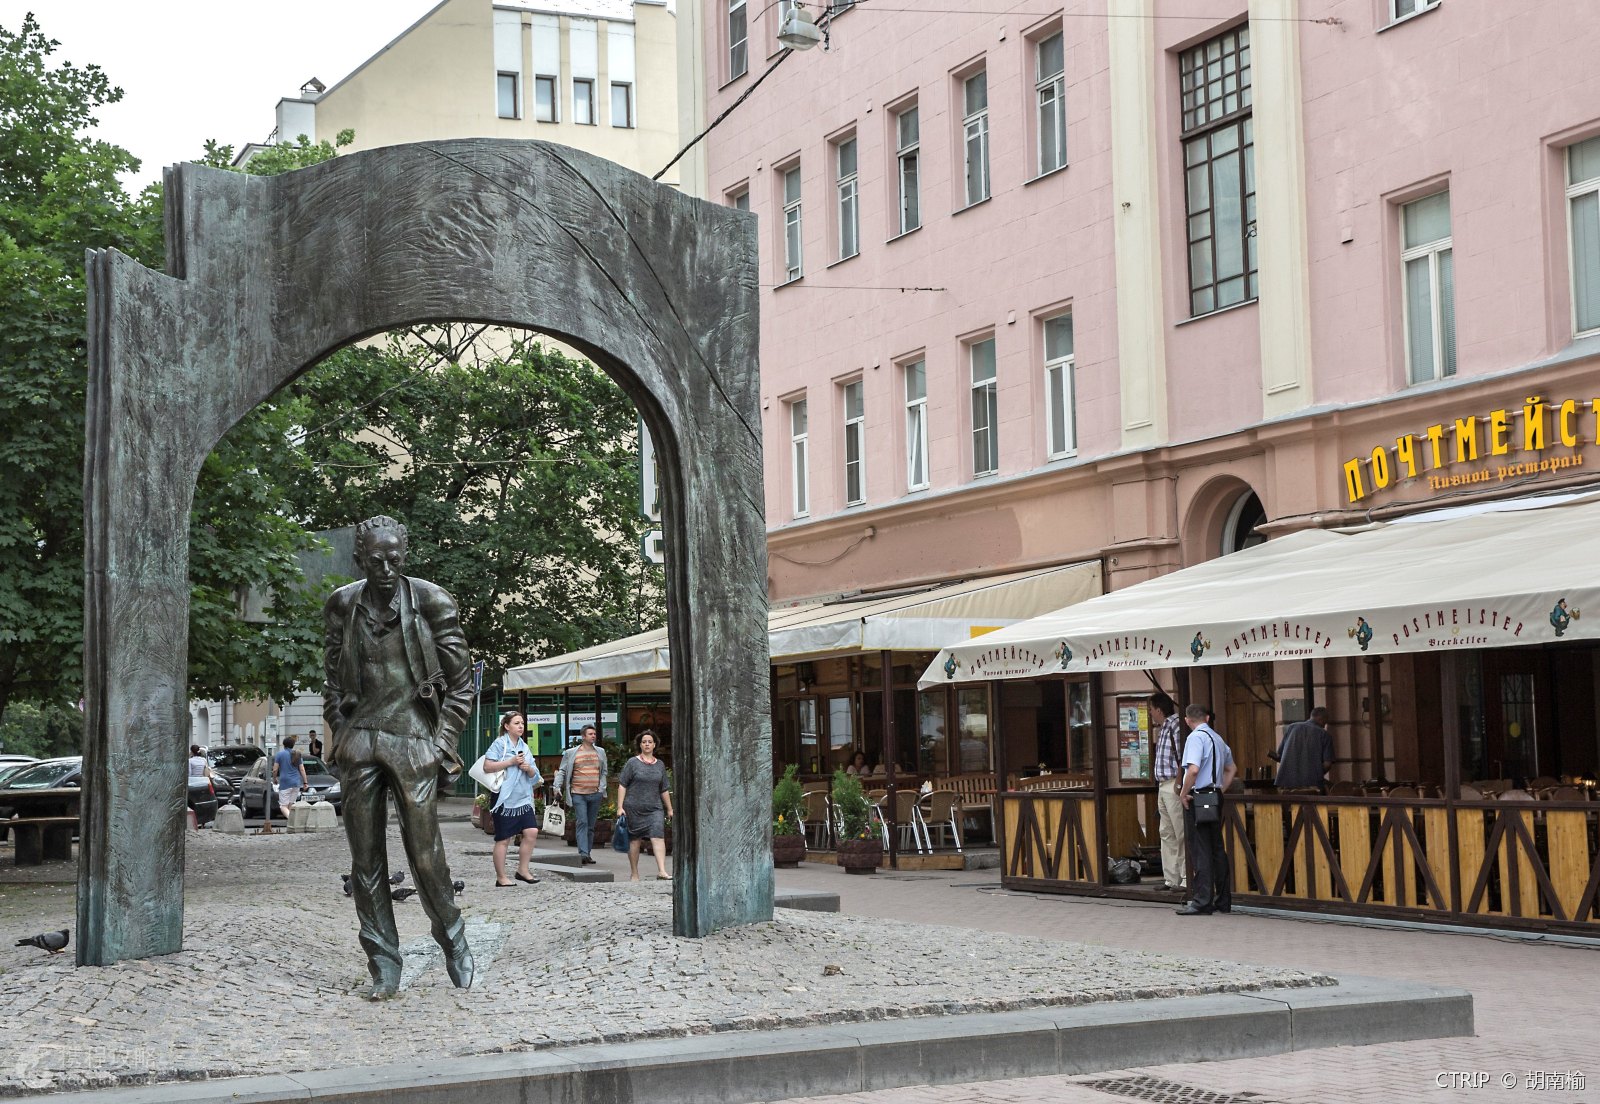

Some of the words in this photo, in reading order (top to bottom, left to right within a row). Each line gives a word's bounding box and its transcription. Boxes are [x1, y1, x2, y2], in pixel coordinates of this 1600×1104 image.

[1427, 470, 1490, 491] Пивной
[1497, 454, 1583, 481] ресторан
[1224, 621, 1331, 658] ПОЧТМЕЙСТЕР
[1392, 608, 1523, 646] POSTMEISTER
[1428, 636, 1488, 647] Bierkeller
[970, 645, 1045, 676] ПОЧТМЕЙСТЕР
[1085, 636, 1172, 666] POSTMEISTER
